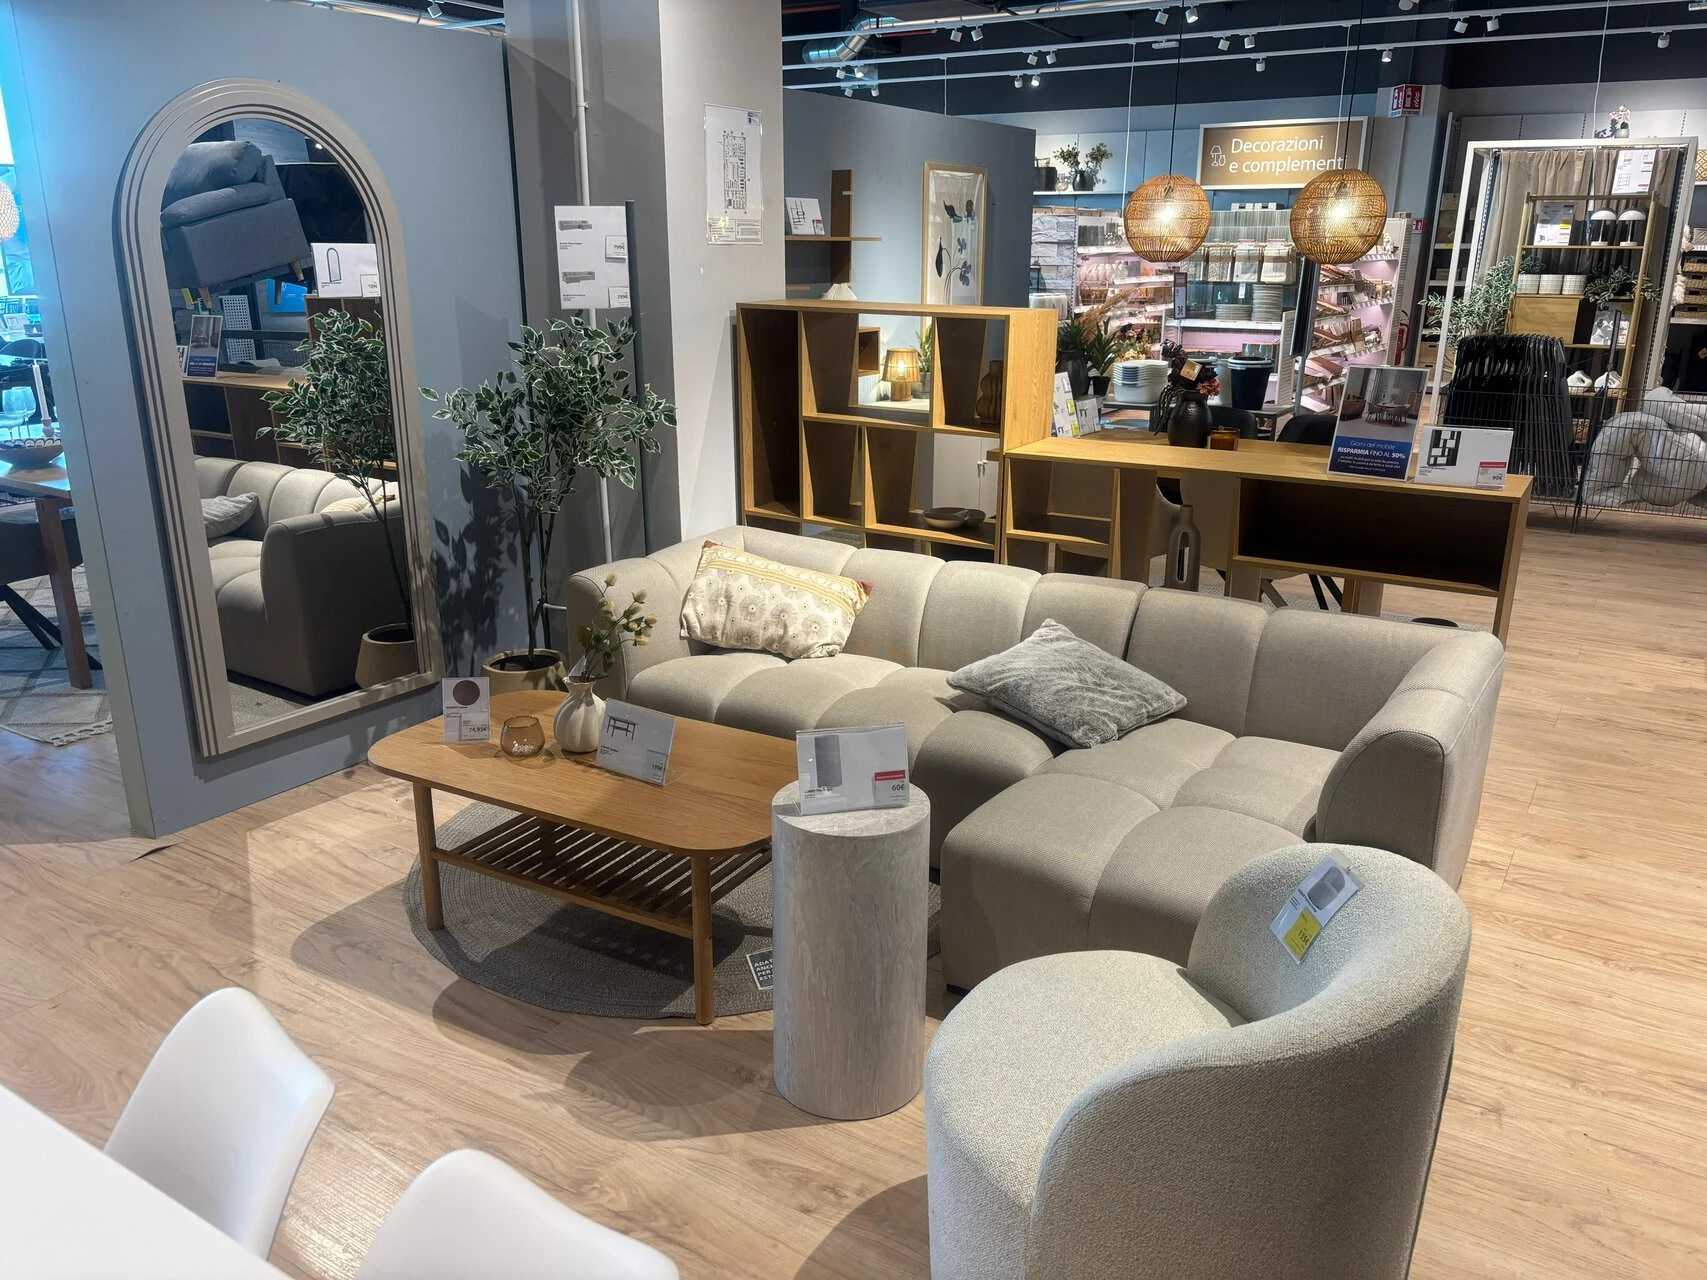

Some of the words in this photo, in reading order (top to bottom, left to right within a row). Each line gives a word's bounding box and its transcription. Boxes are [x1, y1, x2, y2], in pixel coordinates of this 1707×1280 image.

[1231, 135, 1324, 154] Decorazioni
[1229, 161, 1238, 173] e
[1337, 446, 1369, 455] RISPARMIA
